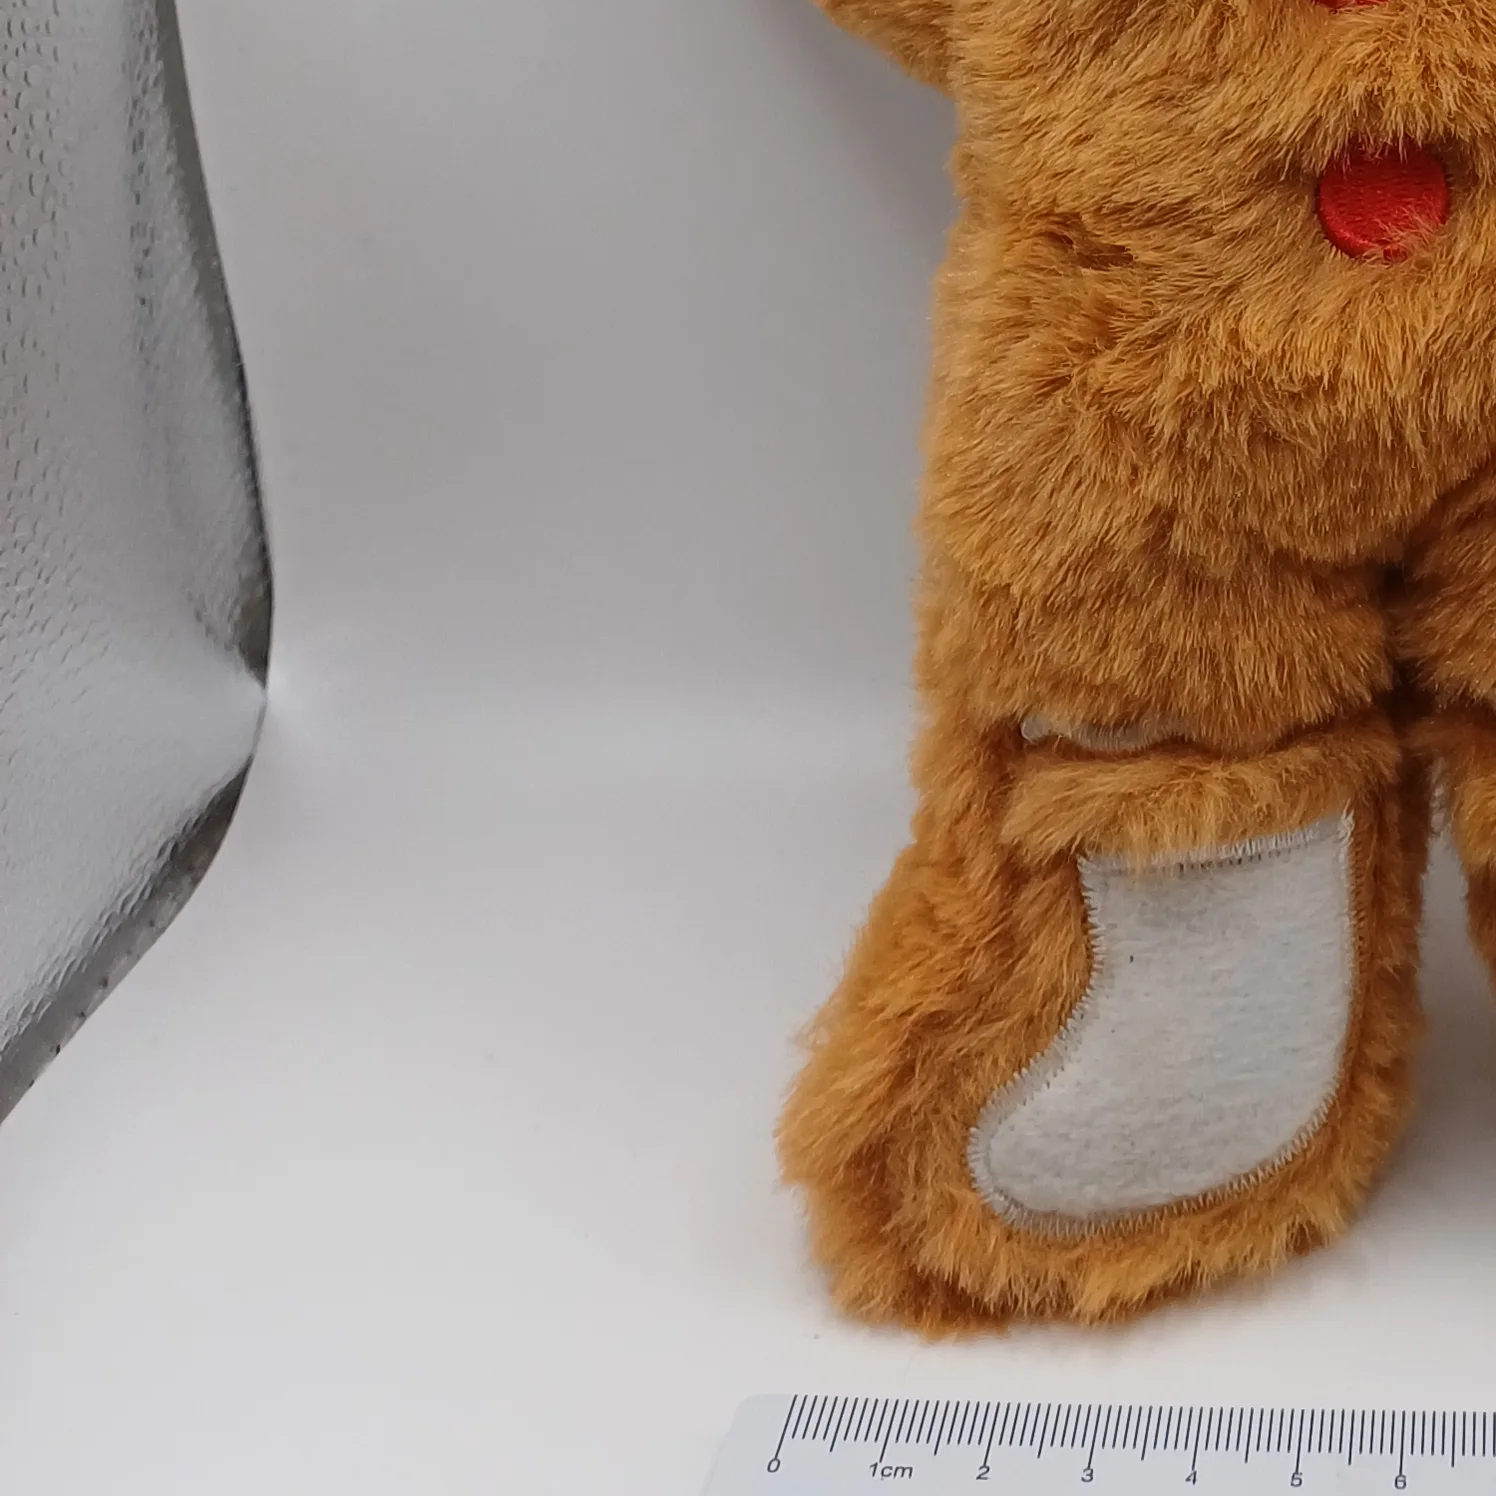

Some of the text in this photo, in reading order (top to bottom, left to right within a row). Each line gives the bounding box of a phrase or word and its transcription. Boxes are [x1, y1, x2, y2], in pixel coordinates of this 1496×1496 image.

[766, 1458, 781, 1473] 0
[975, 1465, 991, 1480] 2
[1080, 1467, 1094, 1483] 3
[1185, 1470, 1199, 1486] 4
[1290, 1472, 1303, 1488] 5
[1394, 1474, 1407, 1490] 6
